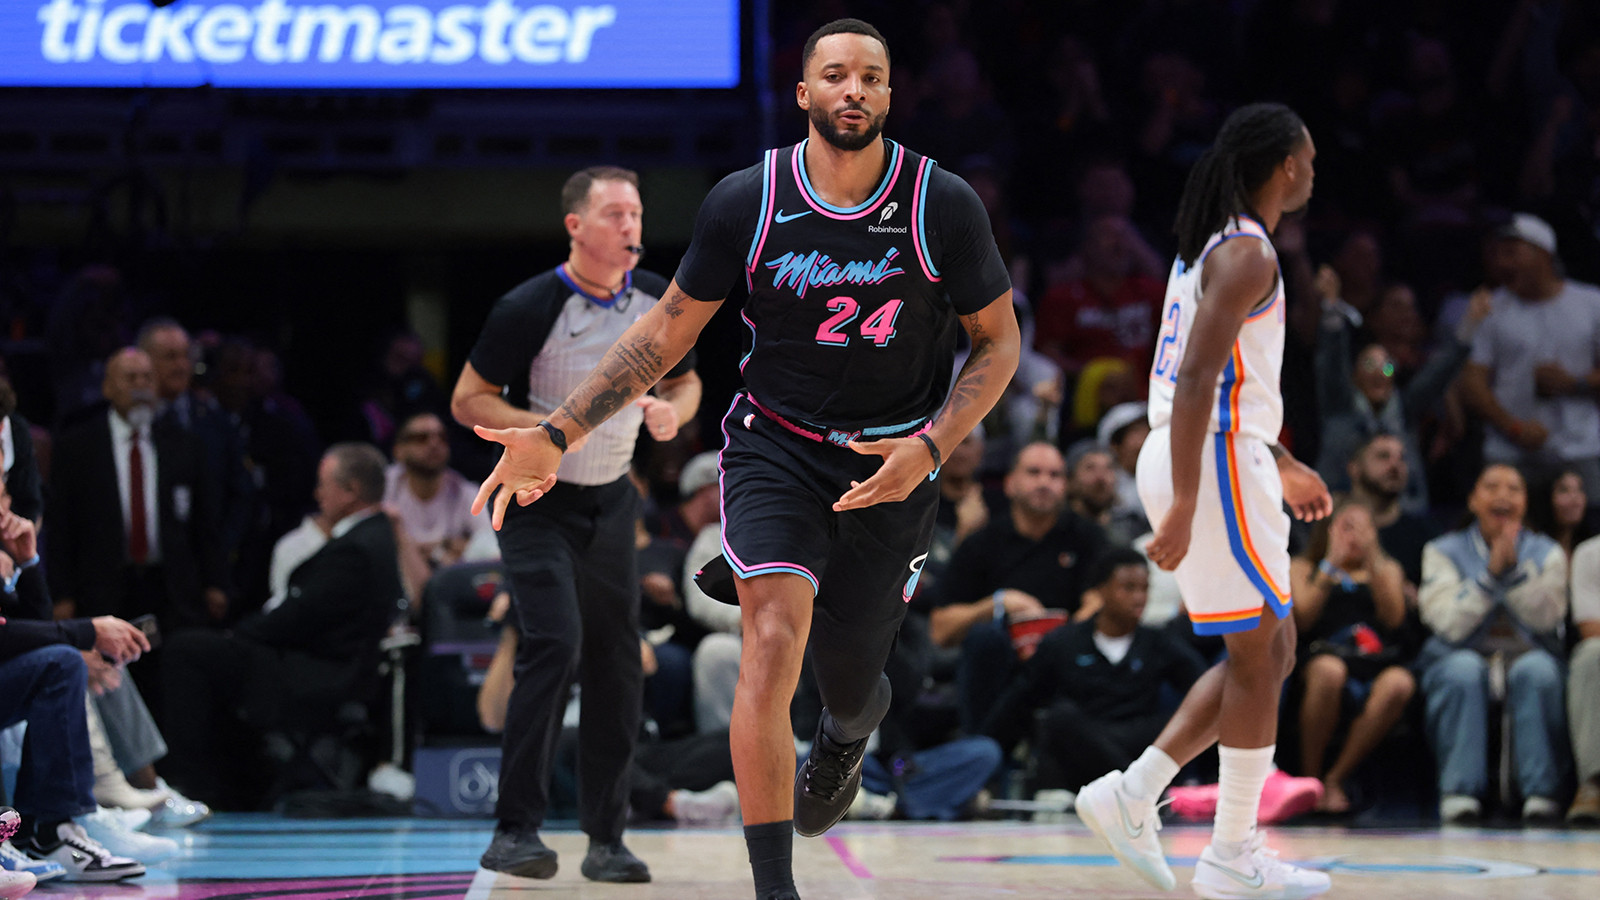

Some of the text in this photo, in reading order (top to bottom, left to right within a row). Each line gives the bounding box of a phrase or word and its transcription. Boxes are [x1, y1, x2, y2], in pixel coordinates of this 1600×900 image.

[37, 0, 616, 64] ticketmaster
[868, 225, 907, 234] Robinhood
[765, 247, 905, 299] Miami
[815, 296, 904, 347] 24
[1151, 298, 1182, 387] 2
